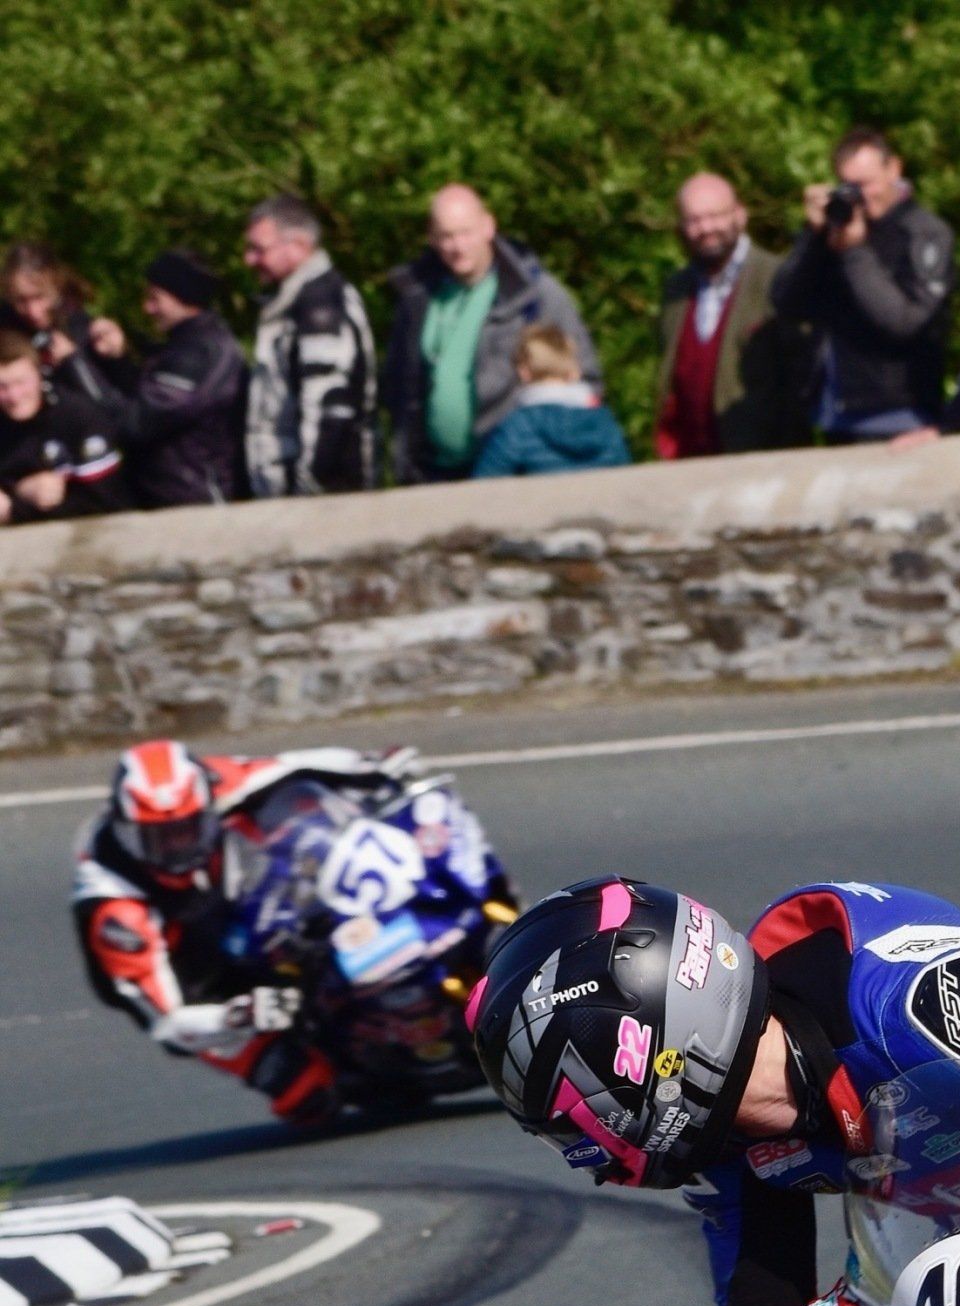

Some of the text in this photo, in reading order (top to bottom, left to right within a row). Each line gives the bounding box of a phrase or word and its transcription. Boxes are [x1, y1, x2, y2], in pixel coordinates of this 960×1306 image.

[528, 980, 600, 1013] TT PHOTO
[613, 1015, 653, 1086] 22
[656, 1106, 681, 1134] AUDI
[656, 1112, 691, 1153] SPARES
